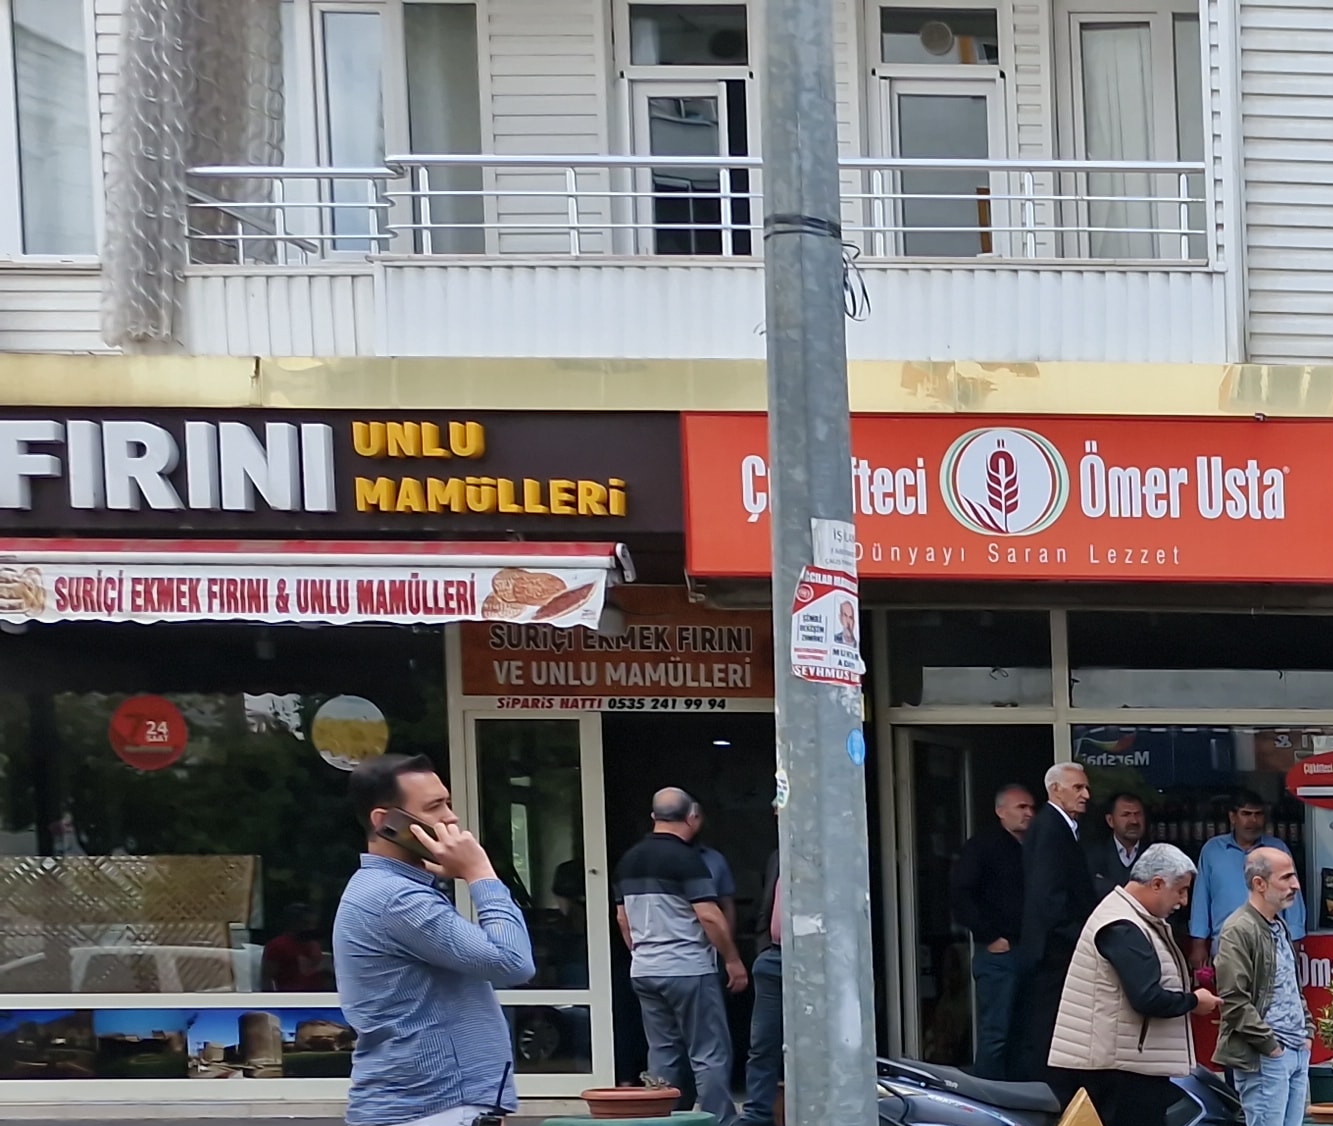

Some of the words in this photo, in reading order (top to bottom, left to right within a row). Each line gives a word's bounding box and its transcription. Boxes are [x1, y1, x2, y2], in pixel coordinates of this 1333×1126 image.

[351, 421, 485, 457] UNLU
[0, 419, 336, 513] FIRINI
[1079, 440, 1188, 519] Ömer
[1196, 456, 1285, 520] Usta
[988, 543, 1067, 565] Saran
[1089, 544, 1180, 565] Lezzet
[55, 570, 124, 617] SURİÇİ
[131, 577, 202, 614] EKMEK
[208, 577, 269, 615] FIRINI
[275, 581, 290, 612] &
[296, 579, 349, 614] UNLU
[356, 572, 477, 616] MAMÜLLERİ
[678, 626, 753, 653] FIRINI
[494, 660, 524, 685] VE
[531, 660, 598, 687] UNLU
[605, 656, 752, 688] MAMÜLLERİ
[559, 698, 603, 710] HATTI
[607, 698, 645, 710] 0535
[651, 698, 677, 710] 241
[683, 698, 703, 710] 99
[708, 698, 726, 710] 94
[145, 720, 169, 735] 24
